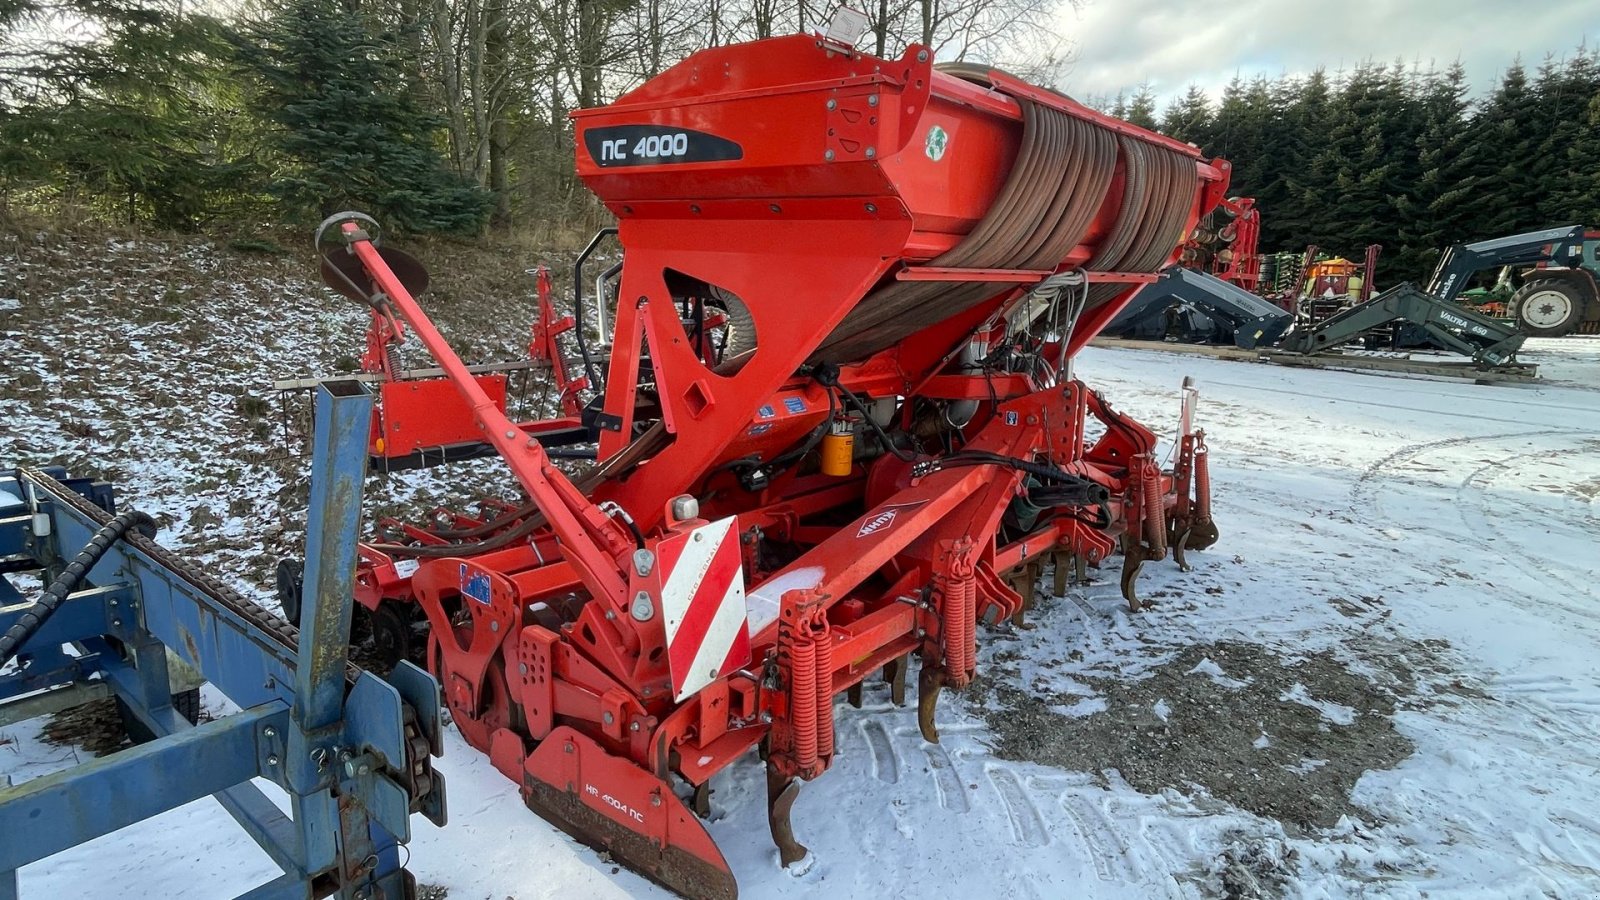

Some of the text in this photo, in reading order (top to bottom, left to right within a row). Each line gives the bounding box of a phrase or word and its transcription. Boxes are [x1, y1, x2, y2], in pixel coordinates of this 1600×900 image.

[633, 133, 688, 159] 4000
[1440, 311, 1488, 336] VALTRA 650
[585, 783, 599, 798] HR
[601, 794, 627, 814] 4004
